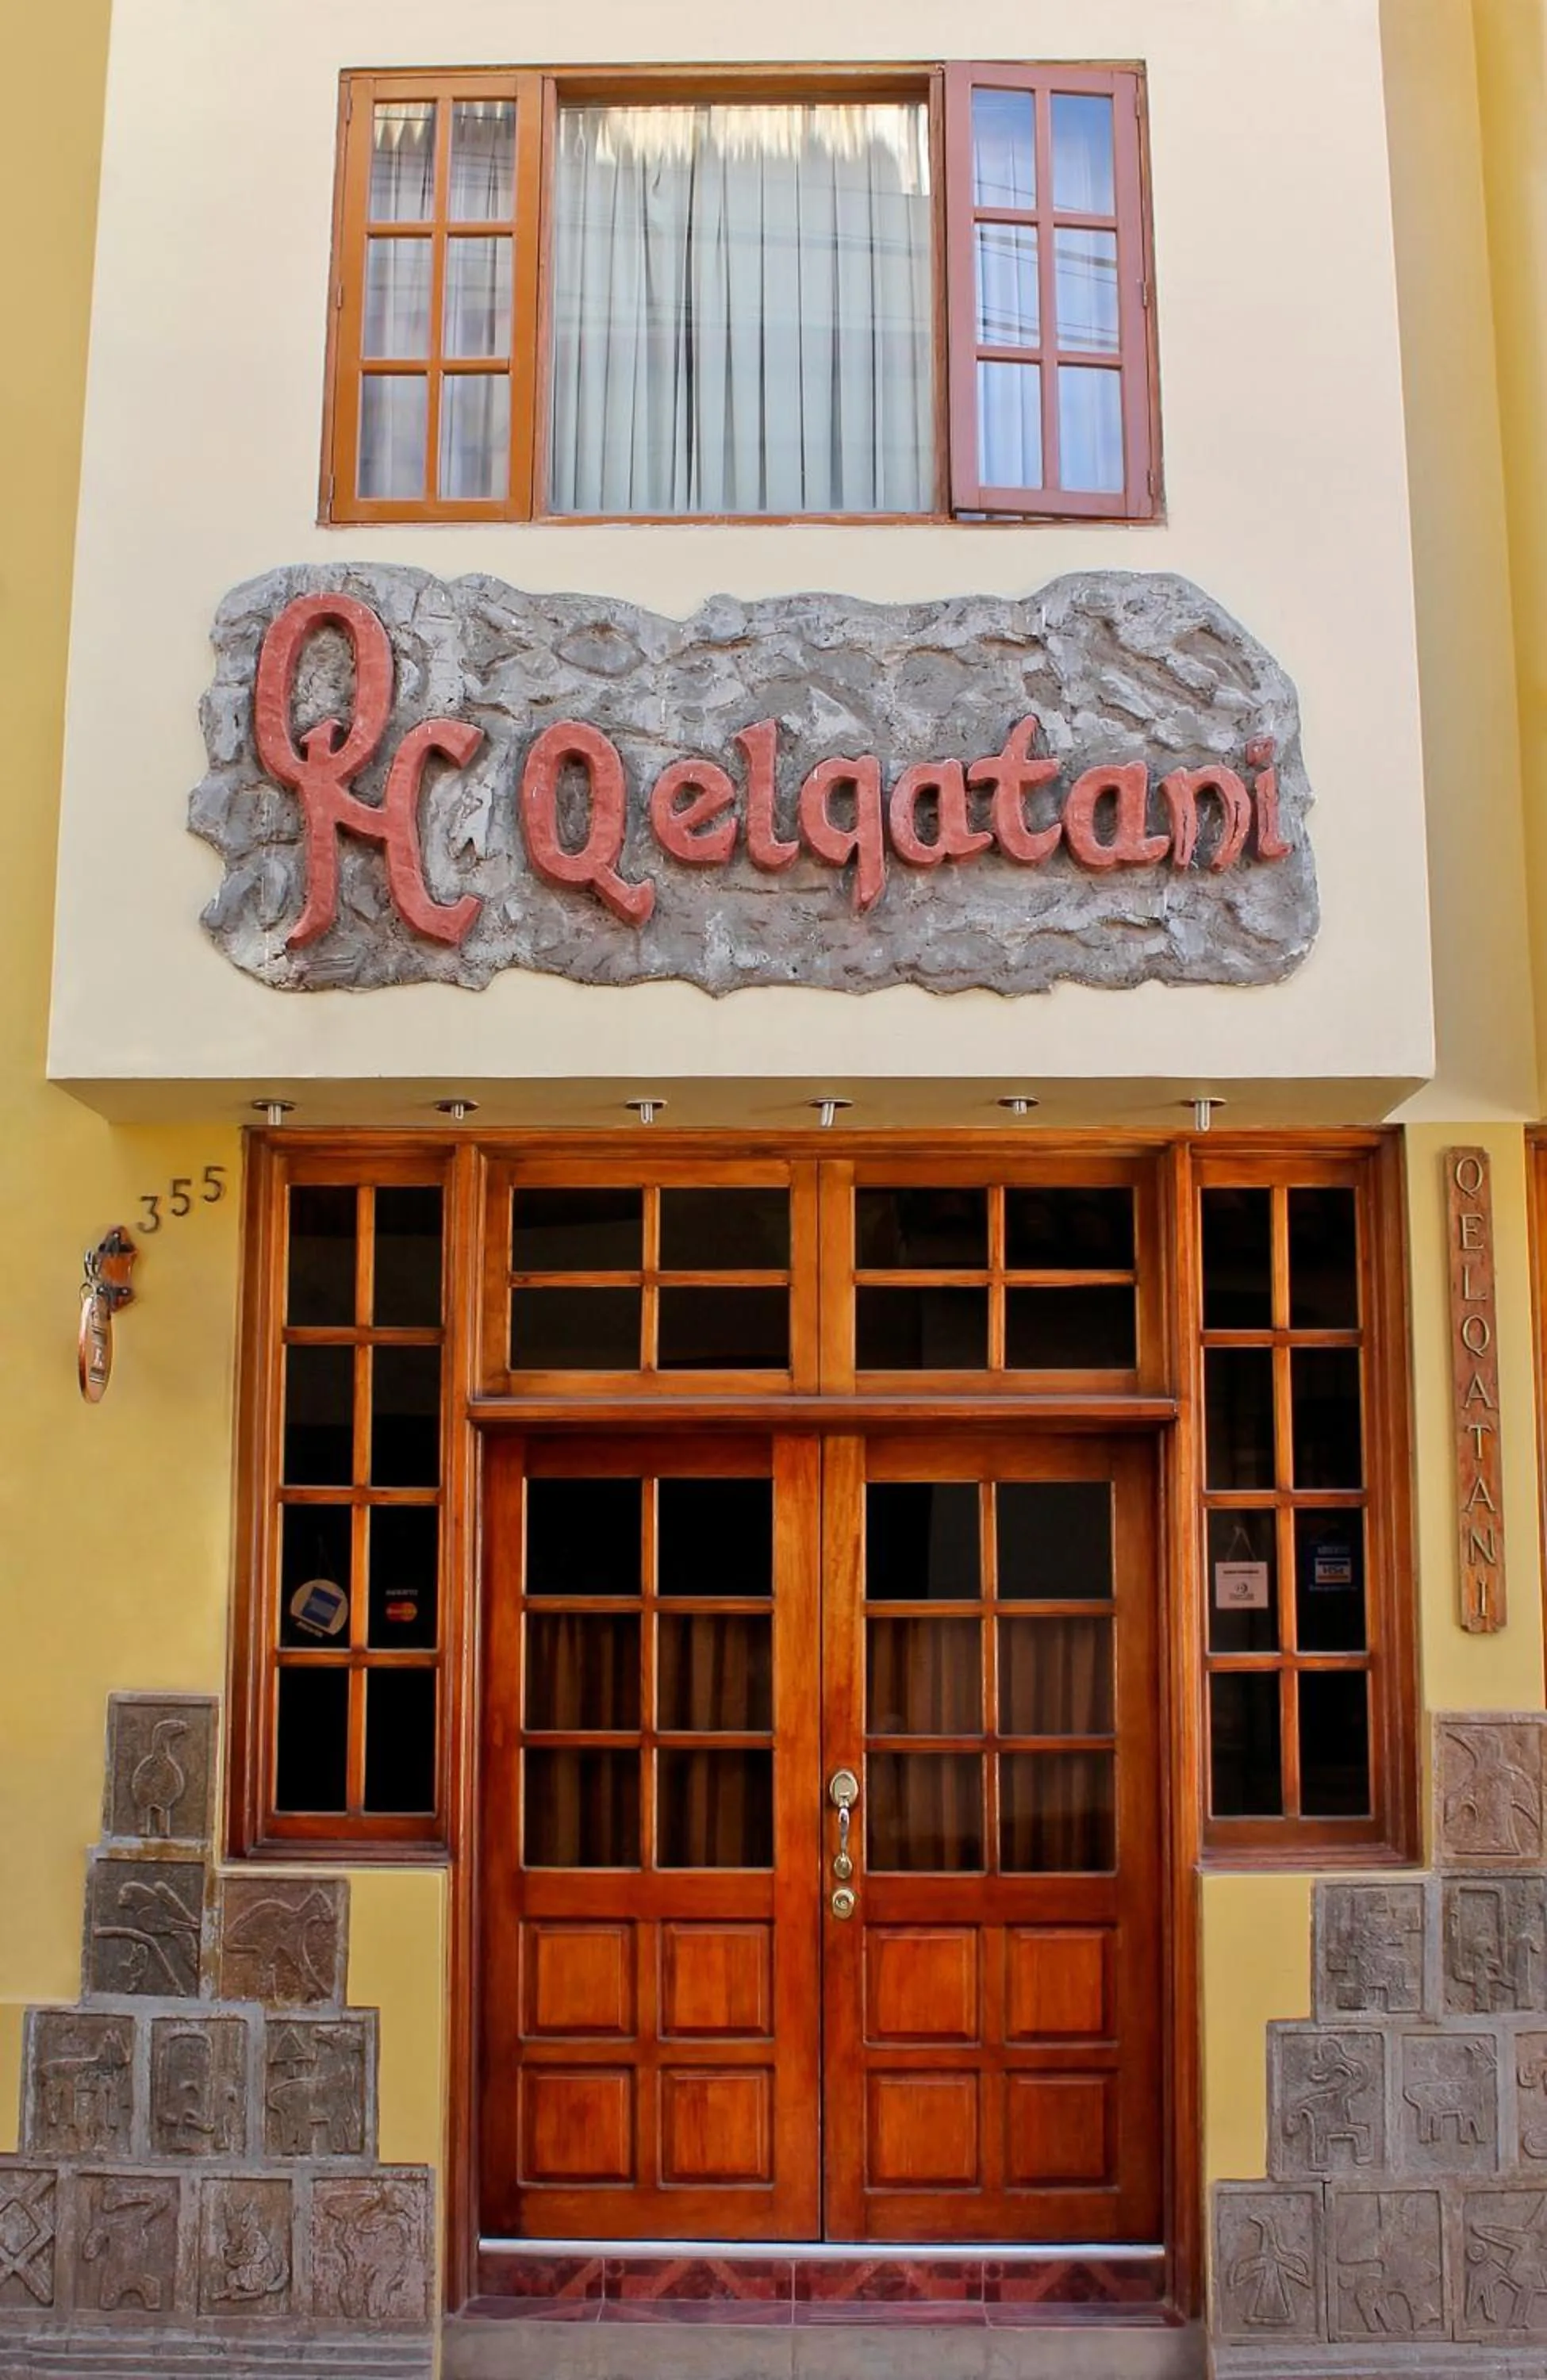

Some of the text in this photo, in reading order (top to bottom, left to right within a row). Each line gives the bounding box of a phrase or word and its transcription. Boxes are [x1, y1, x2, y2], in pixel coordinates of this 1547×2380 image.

[520, 712, 1292, 927] Qelqatani
[136, 1165, 227, 1234] 355
[1454, 1155, 1497, 1620] QELQATANI
